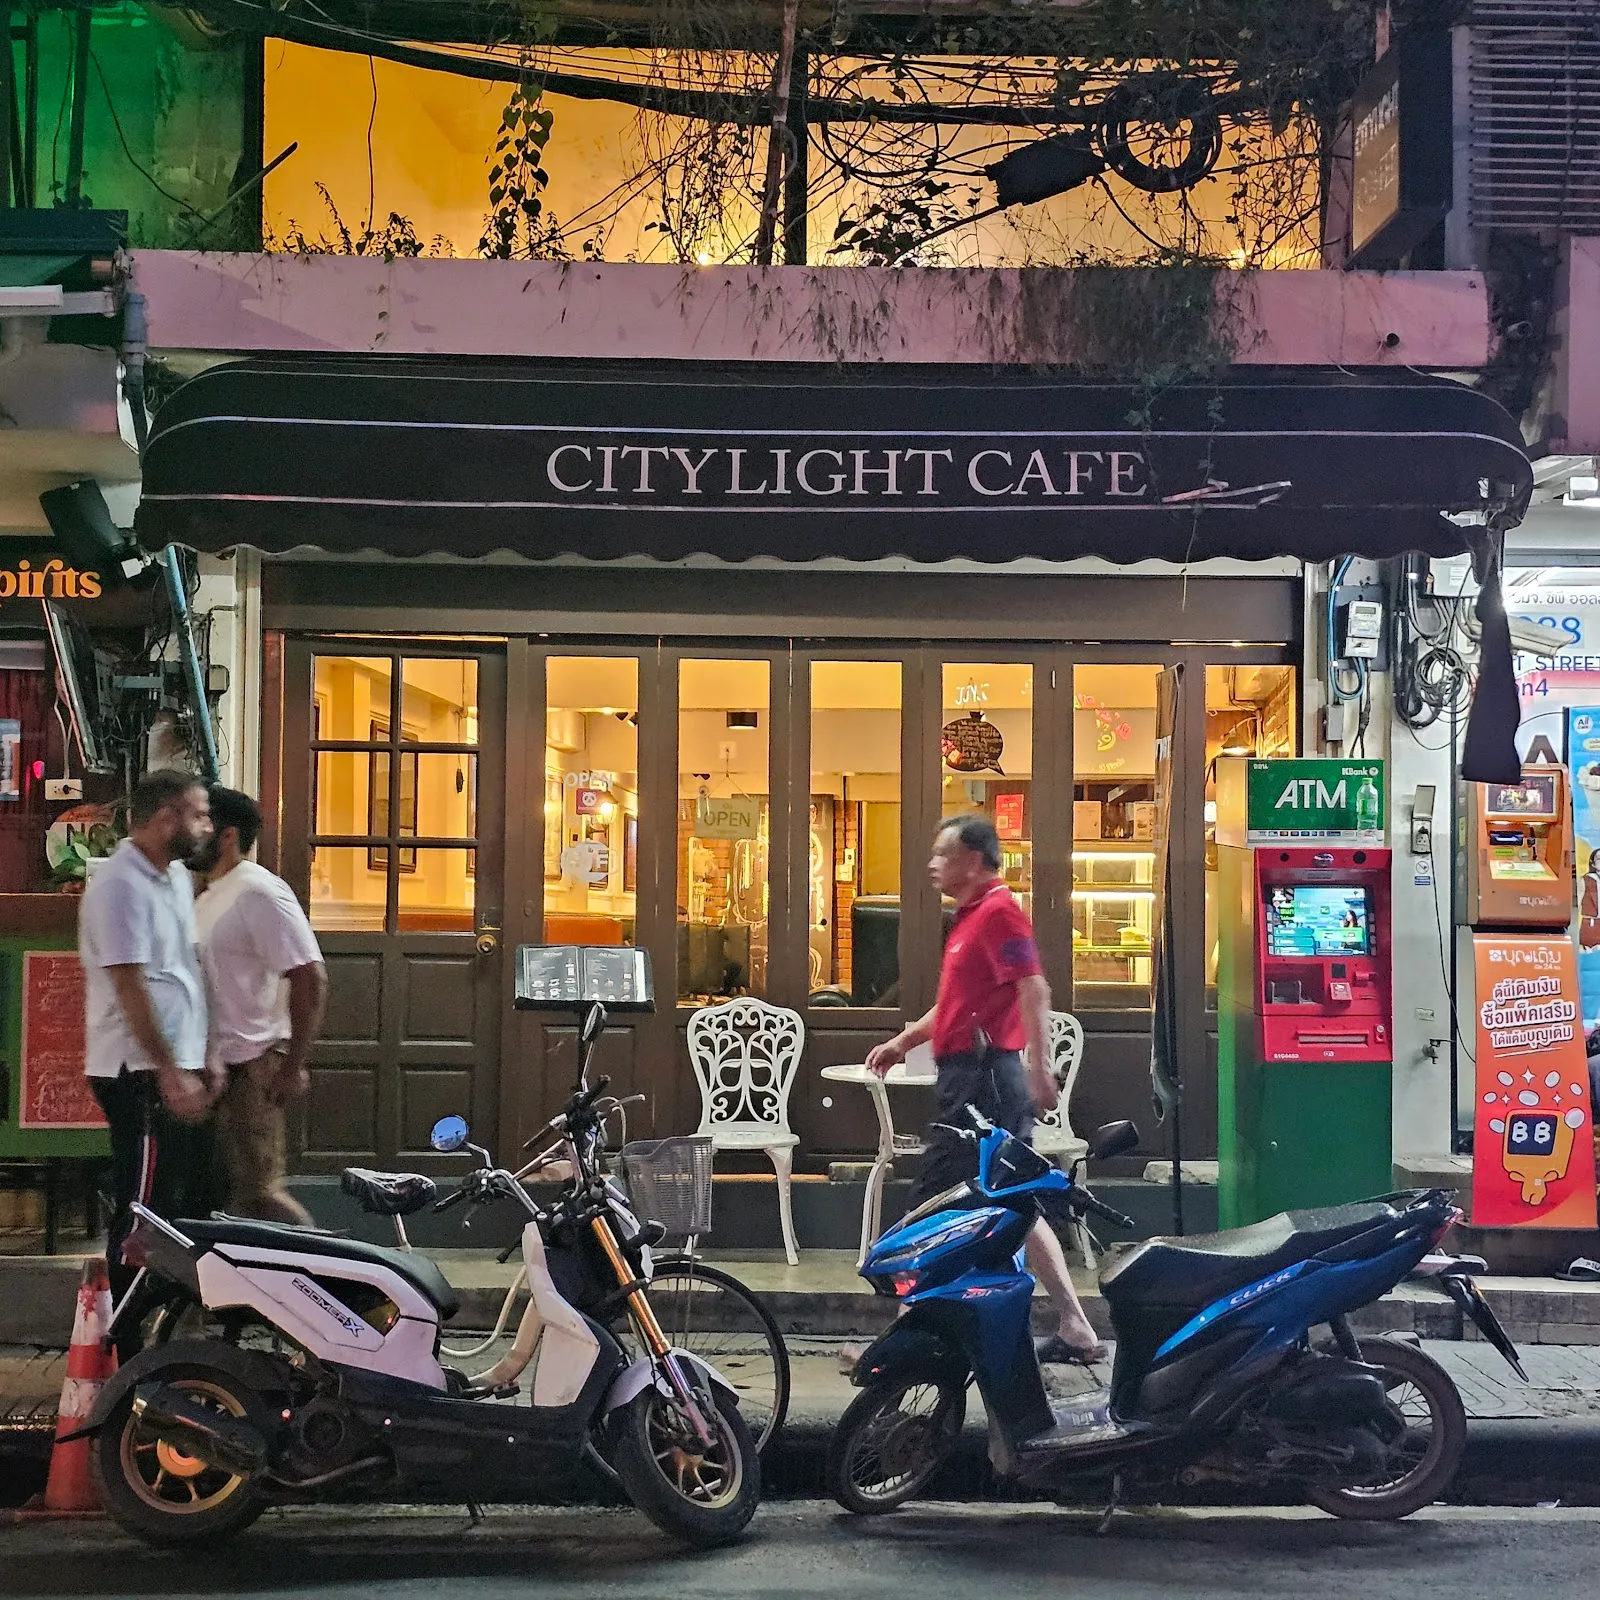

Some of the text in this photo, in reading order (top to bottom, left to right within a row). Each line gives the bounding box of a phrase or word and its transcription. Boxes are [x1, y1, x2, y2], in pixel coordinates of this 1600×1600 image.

[968, 448, 1148, 497] CAFE
[564, 771, 613, 789] OPEN
[1341, 766, 1369, 776] KBank
[1274, 779, 1346, 809] ATM
[703, 810, 751, 828] OPEN
